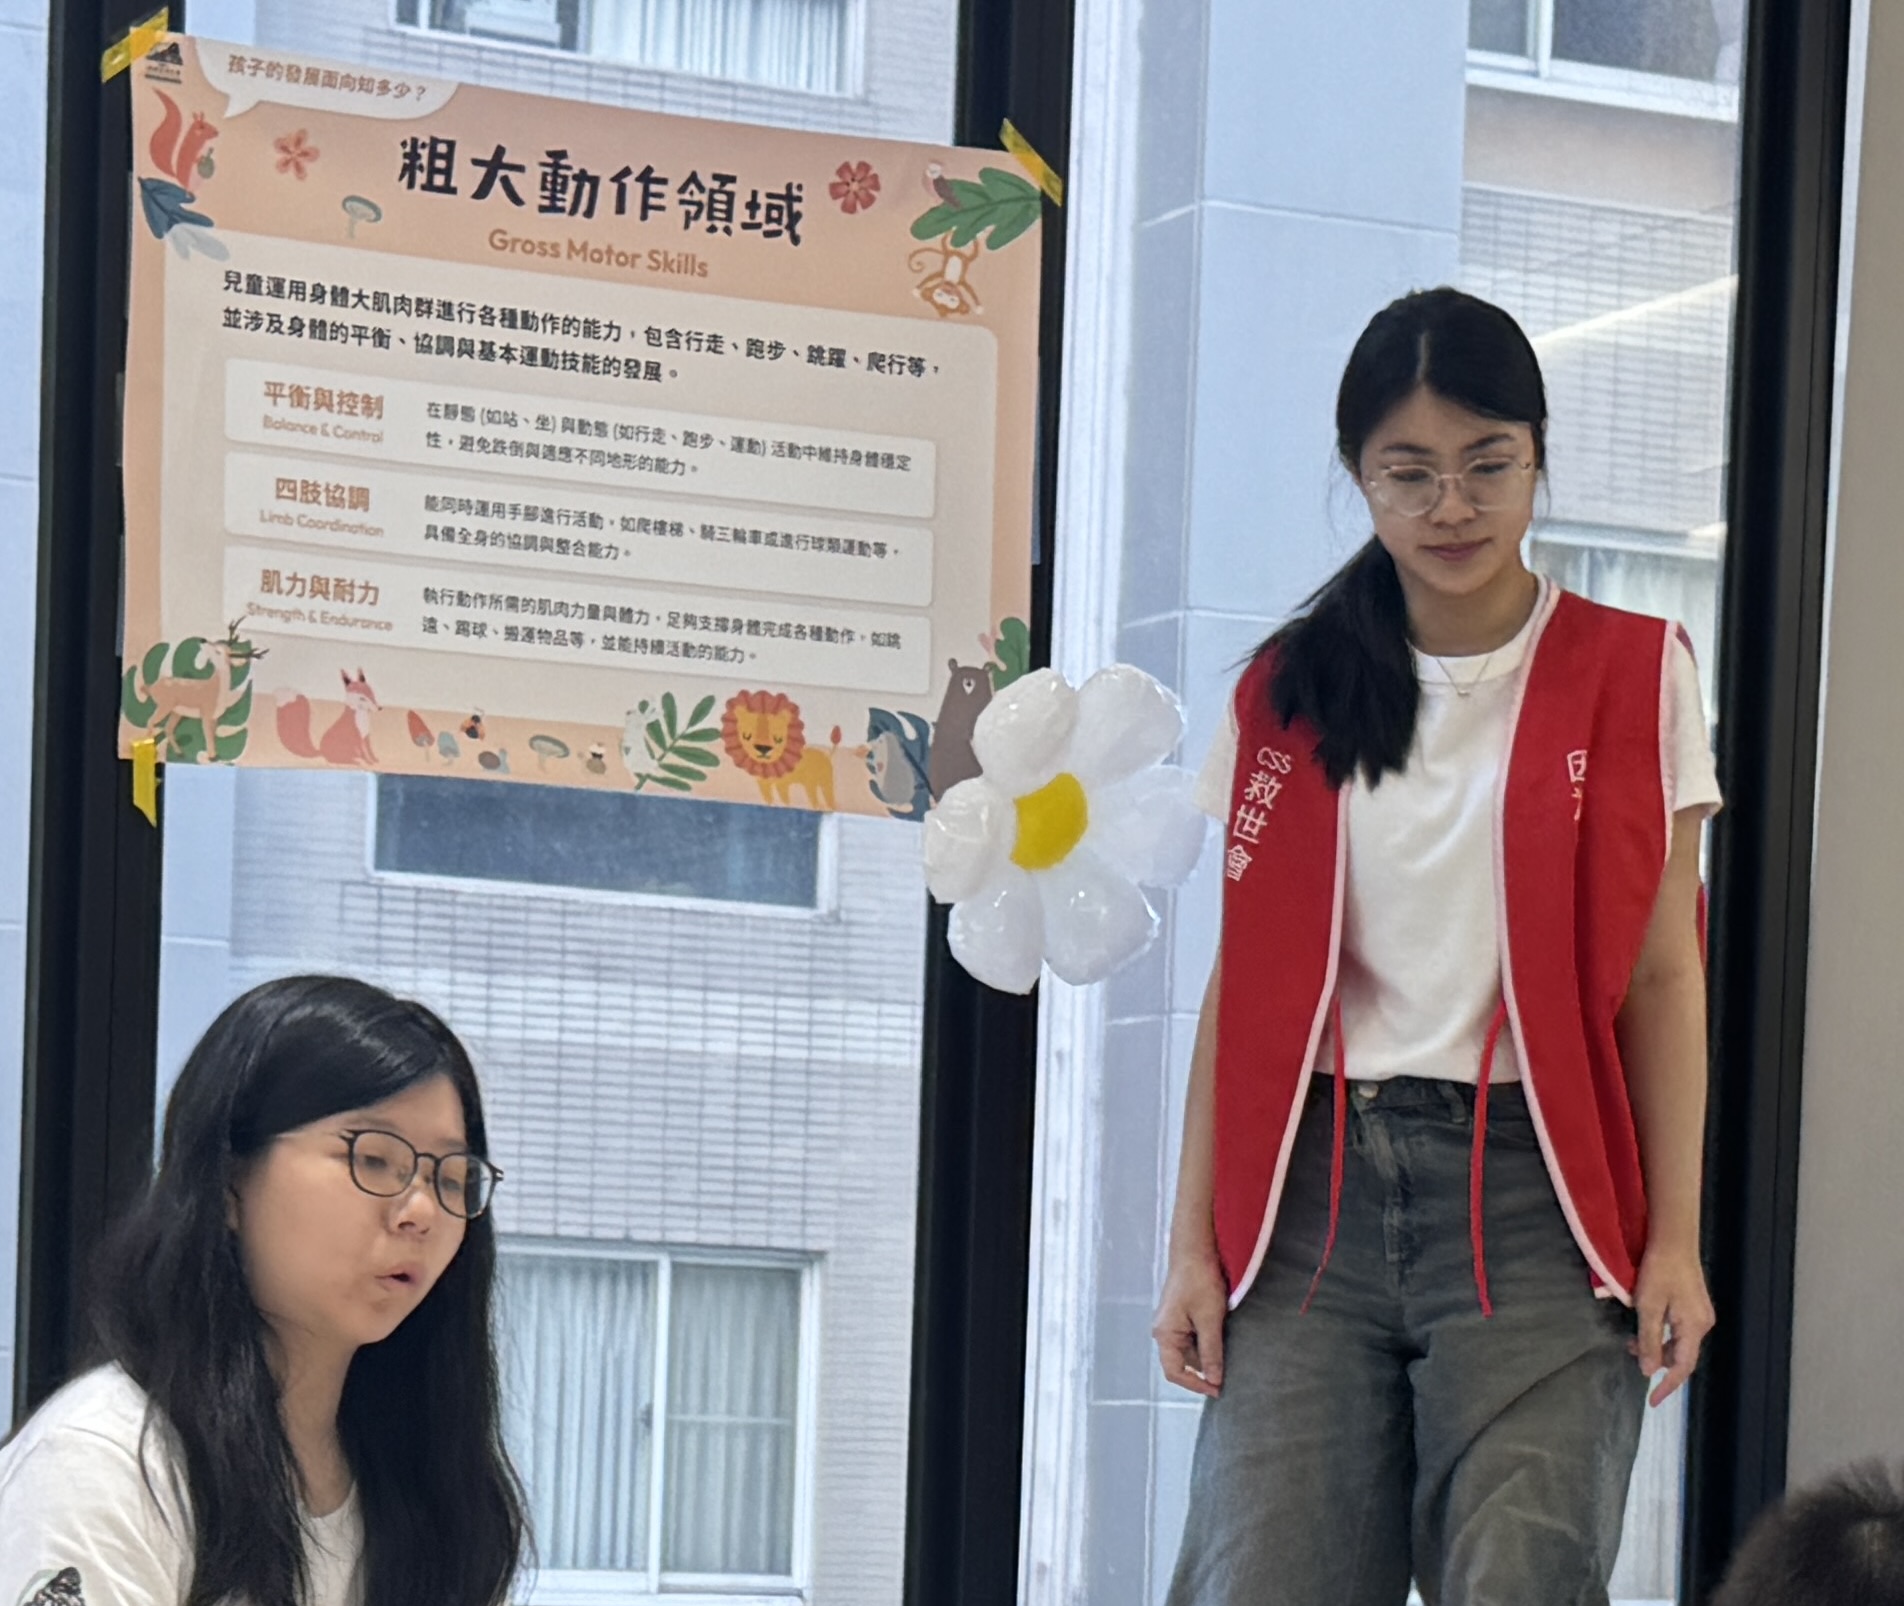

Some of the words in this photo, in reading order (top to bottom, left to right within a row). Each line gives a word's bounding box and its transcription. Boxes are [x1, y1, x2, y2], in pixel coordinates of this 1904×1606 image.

[228, 54, 426, 101] 孩子的發展面向知多少？
[399, 135, 803, 246] 粗大動作領域
[488, 228, 561, 259] Gross
[567, 238, 641, 268] Motor
[647, 248, 708, 277] Skills
[264, 381, 384, 420] 平衡與控制
[263, 415, 318, 435] Balance
[321, 423, 331, 437] &
[334, 425, 384, 443] Control
[274, 477, 371, 512] 四肢協調
[260, 510, 293, 527] Limb
[297, 514, 384, 538] Coordination
[261, 569, 380, 606] 肌力與耐力
[247, 602, 305, 625] Strength
[308, 610, 318, 624] &
[320, 611, 393, 631] Endurance
[1227, 769, 1284, 882] 救世會
